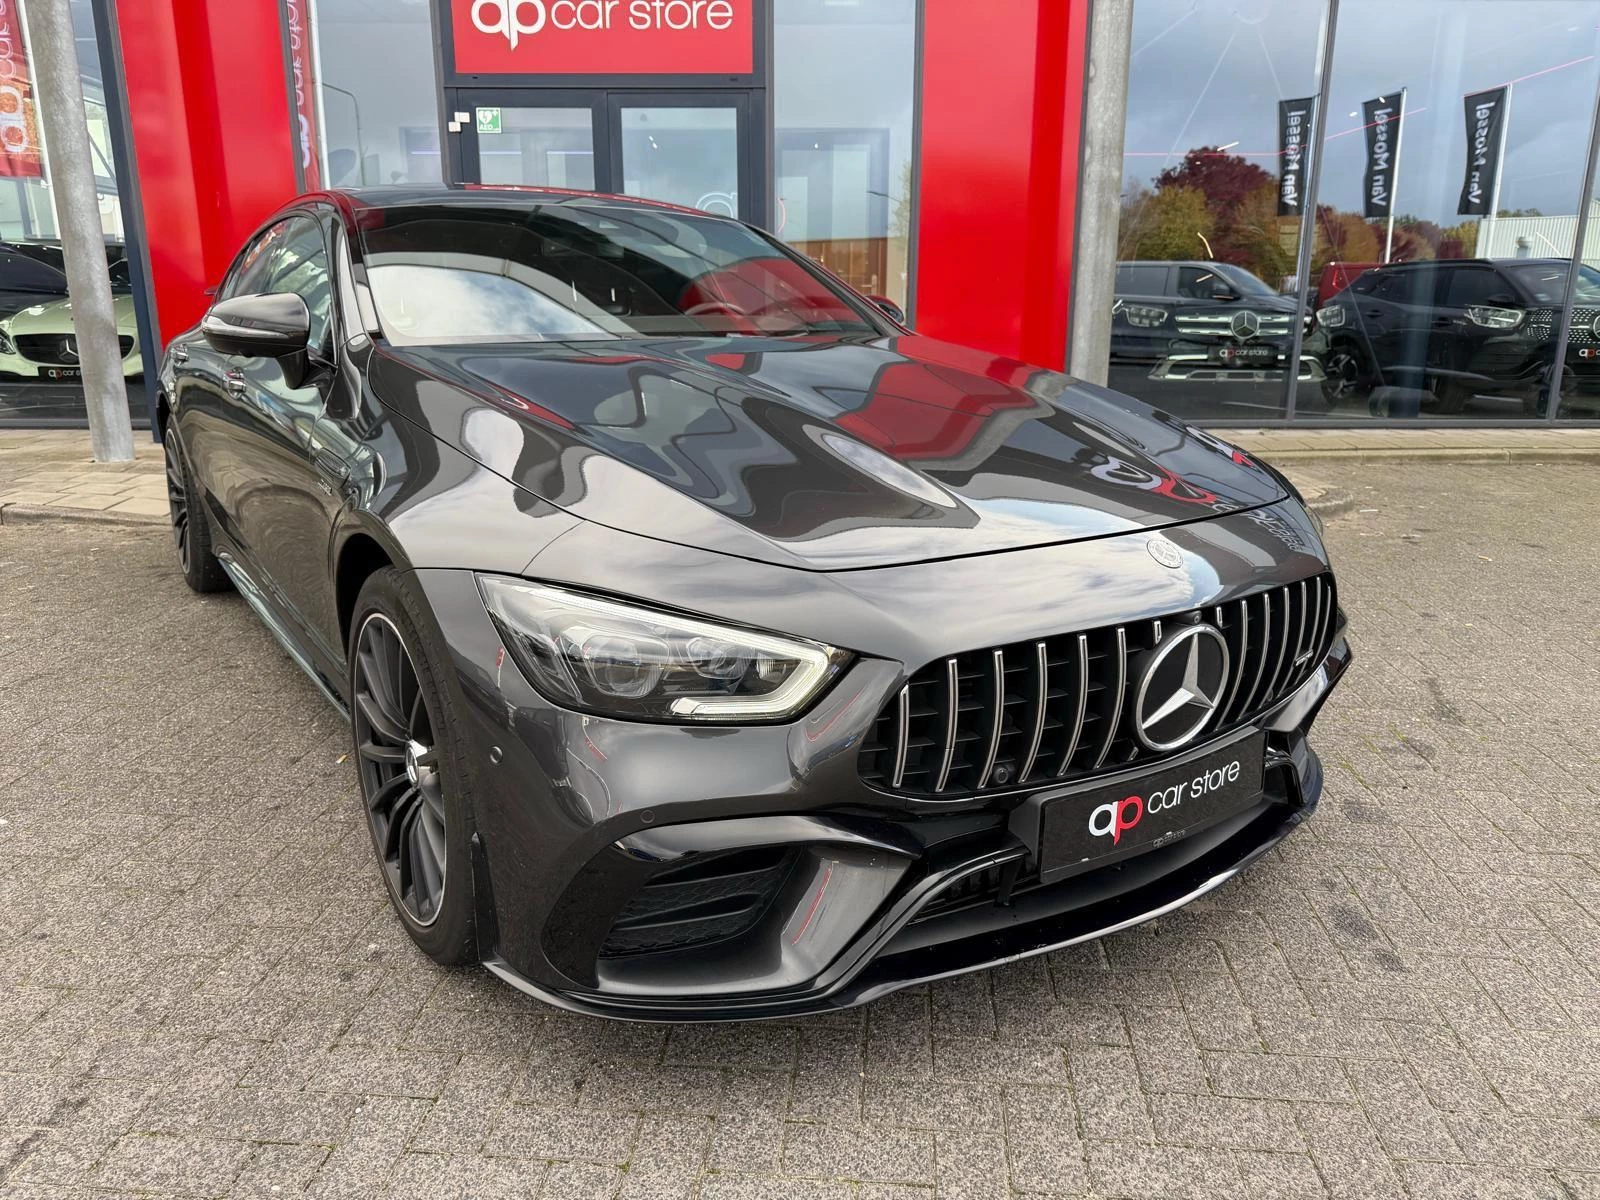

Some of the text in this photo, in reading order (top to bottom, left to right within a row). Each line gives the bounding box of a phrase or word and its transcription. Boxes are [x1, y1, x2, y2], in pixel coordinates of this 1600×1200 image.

[551, 0, 619, 29] car
[628, 0, 734, 30] store
[1089, 796, 1142, 846] ap
[1147, 783, 1188, 814] car
[1191, 761, 1240, 798] store
